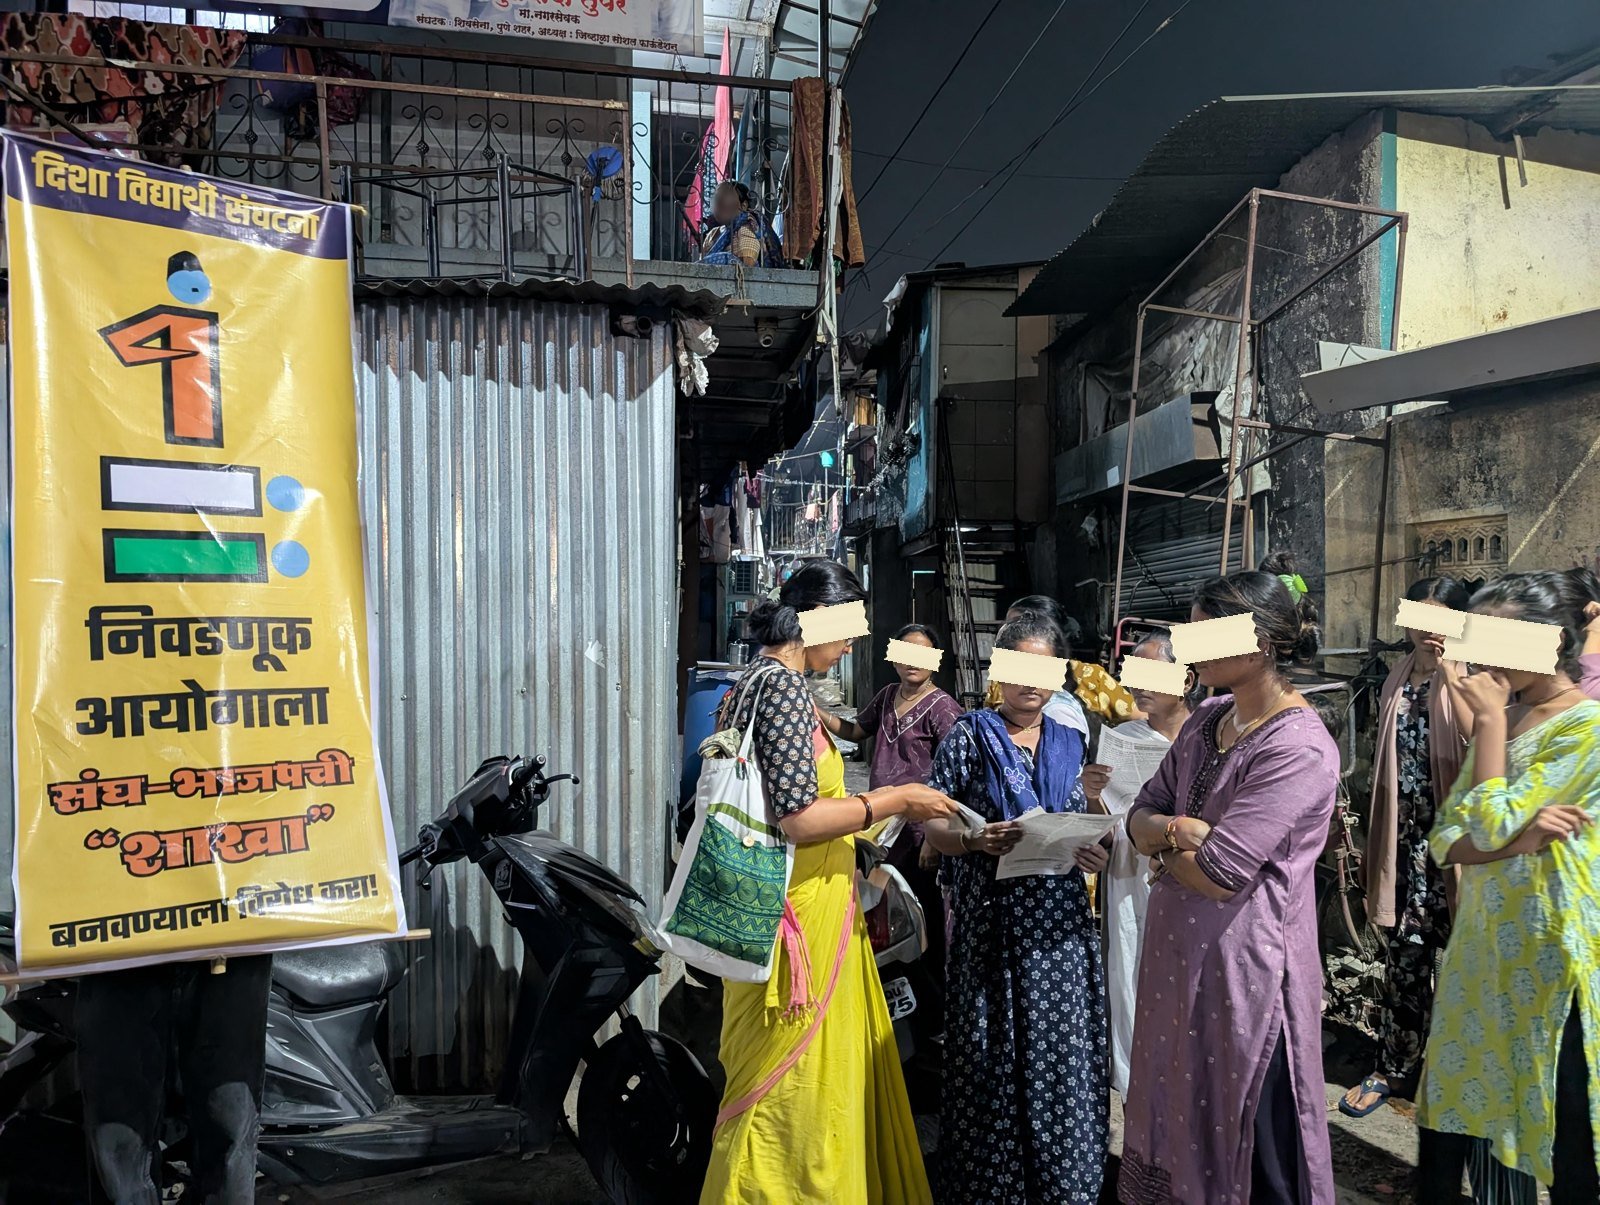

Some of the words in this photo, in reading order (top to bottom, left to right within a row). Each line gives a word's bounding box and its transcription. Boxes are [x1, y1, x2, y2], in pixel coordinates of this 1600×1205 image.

[453, 16, 493, 32] शिवसेना,
[496, 21, 511, 35] पुणे
[512, 24, 535, 37] शहर,
[611, 33, 637, 47] सोशल
[31, 150, 111, 198] दिशा
[115, 167, 219, 218] विद्यार्थी
[221, 193, 320, 240] संघटना
[84, 605, 313, 672] निवडणूक
[75, 679, 330, 738] आयोगाला
[49, 896, 230, 948] बनवण्याला
[235, 881, 314, 919] विरोध
[318, 874, 378, 901] करा!
